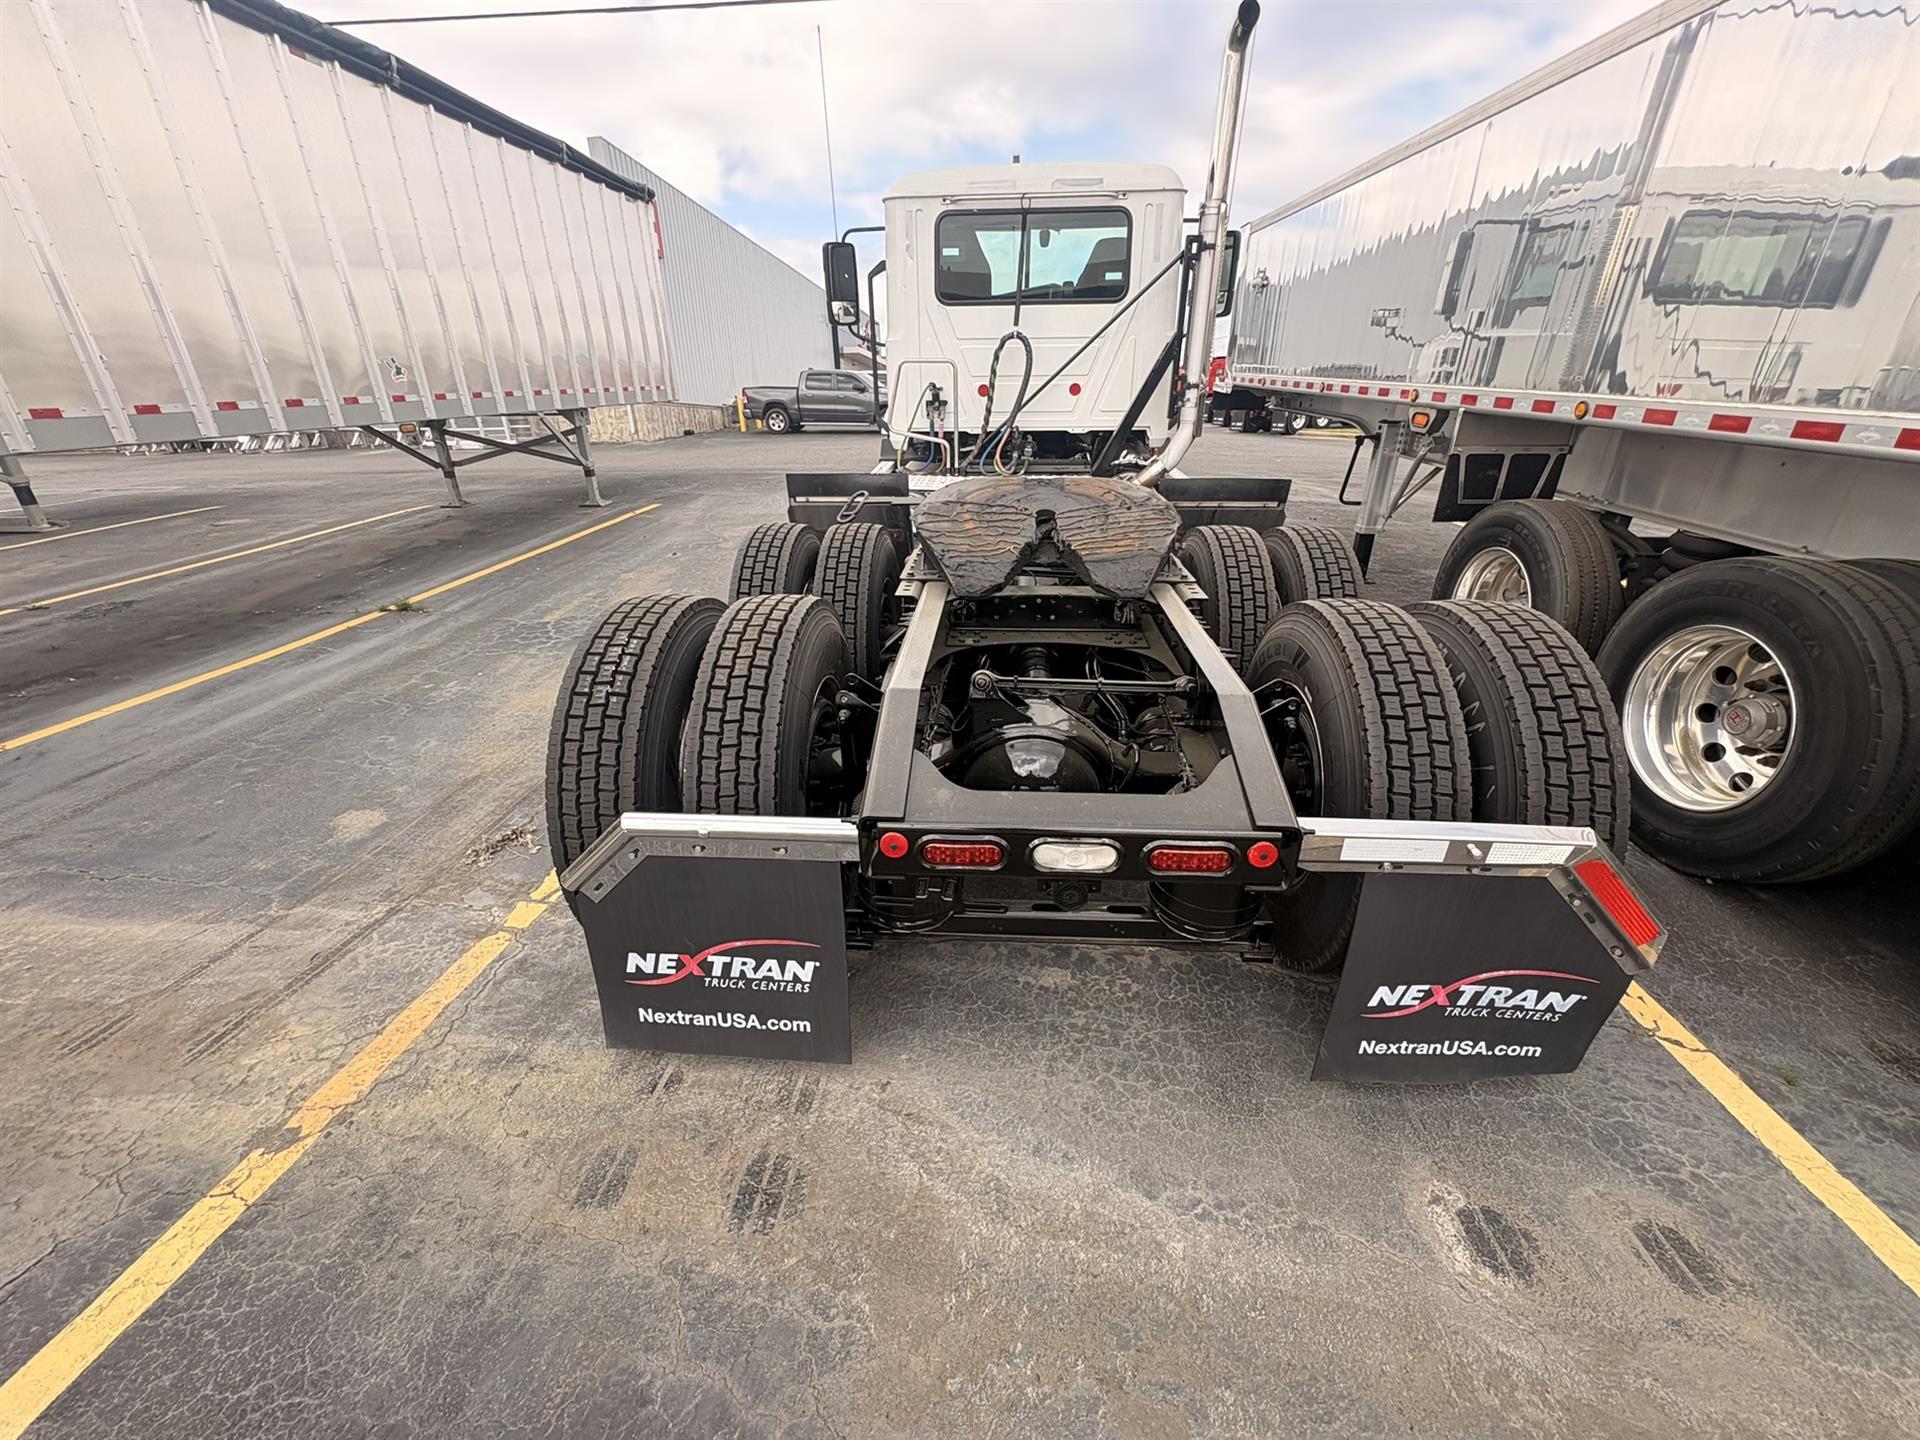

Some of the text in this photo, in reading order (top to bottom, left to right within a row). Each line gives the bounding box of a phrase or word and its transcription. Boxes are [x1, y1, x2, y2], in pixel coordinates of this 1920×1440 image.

[625, 951, 820, 983] NEXTRAN
[704, 977, 811, 993] TRUCK CENTERS
[1367, 984, 1588, 1013] NEXTRAN
[638, 1007, 811, 1033] NextranUSA.com
[1444, 1007, 1563, 1022] TRUCK CENTERS
[1358, 1039, 1542, 1057] NextranUSA.com
